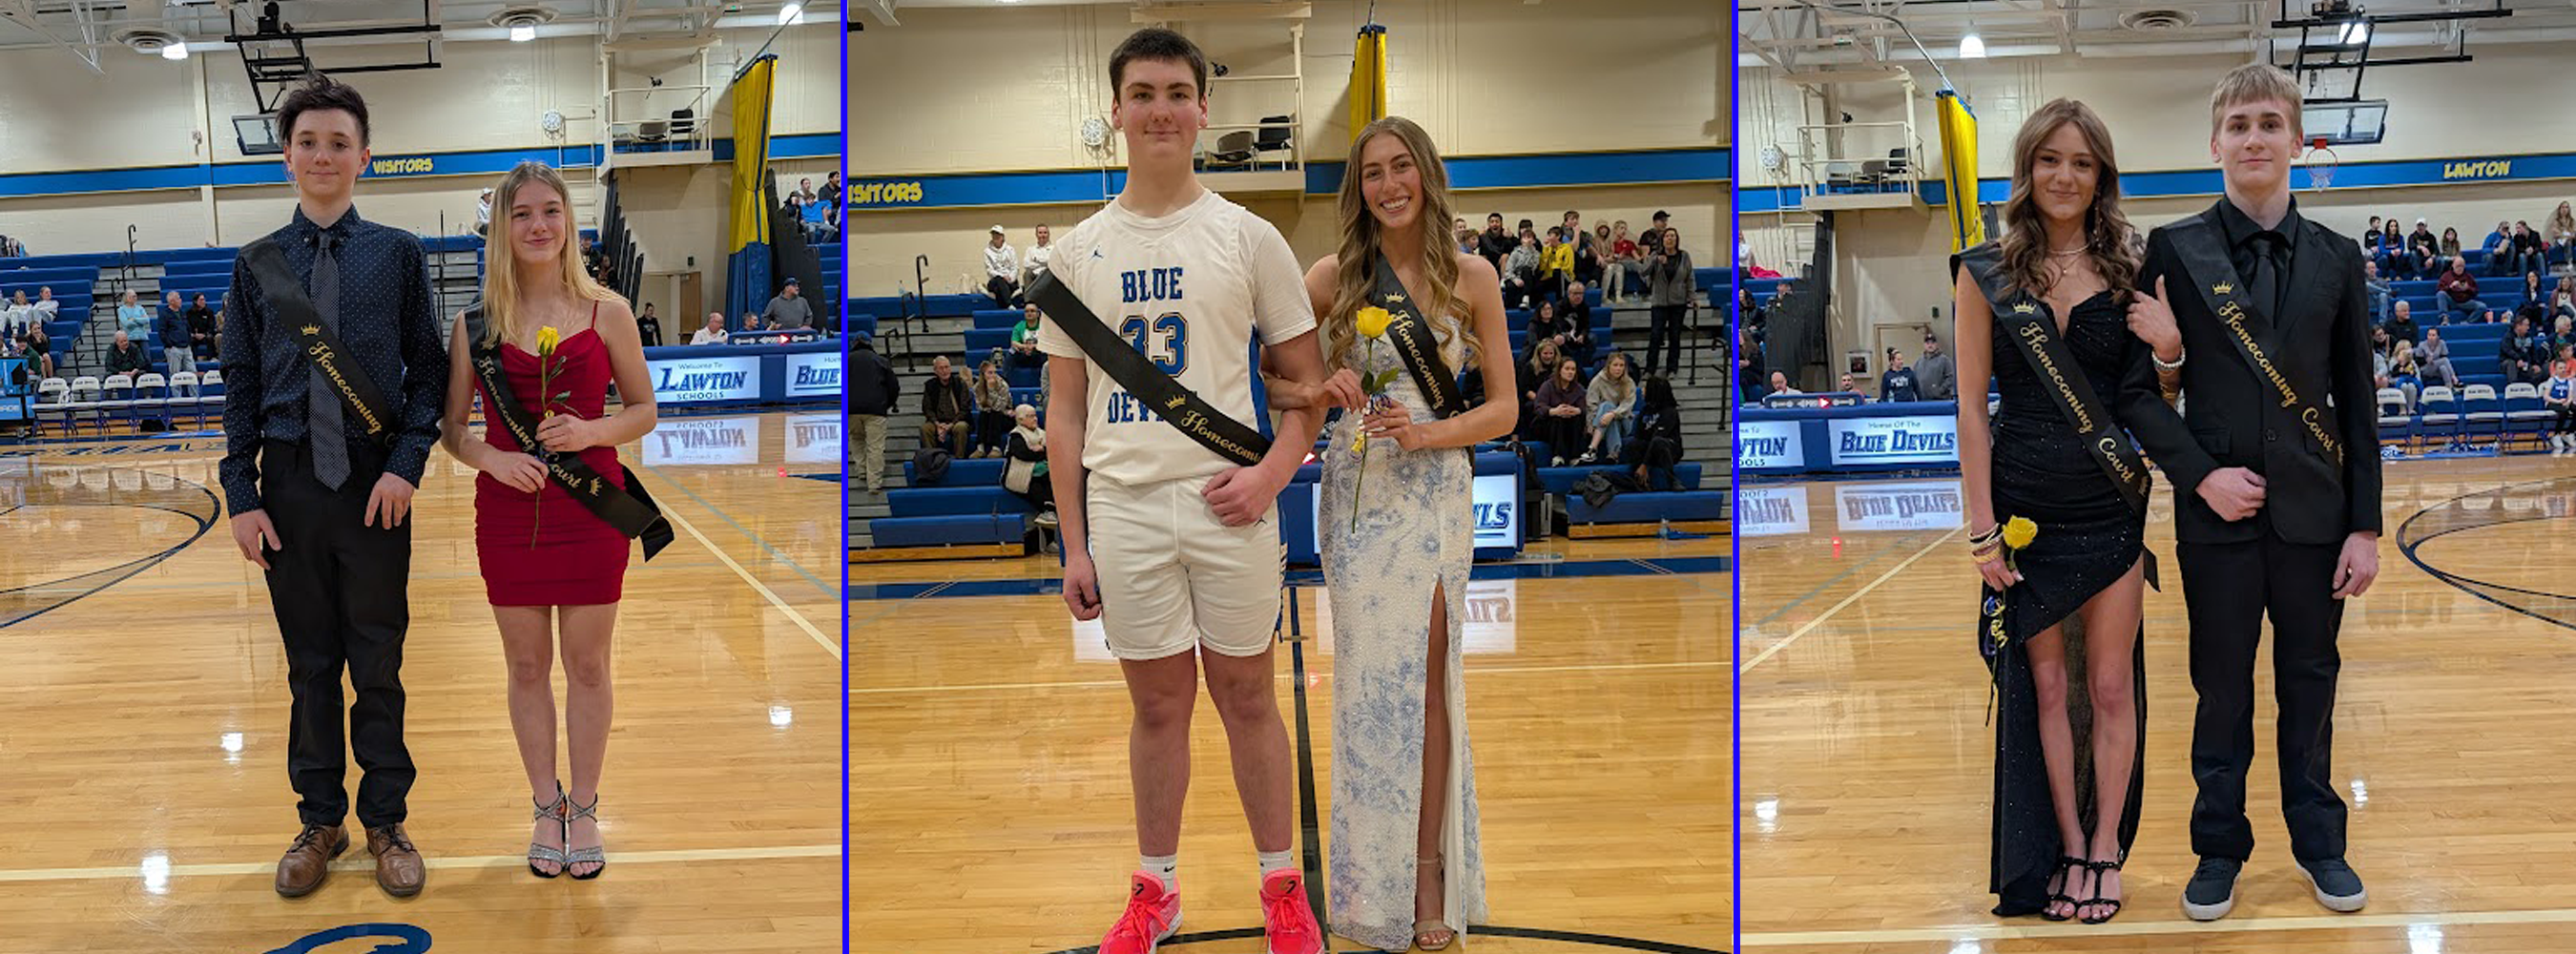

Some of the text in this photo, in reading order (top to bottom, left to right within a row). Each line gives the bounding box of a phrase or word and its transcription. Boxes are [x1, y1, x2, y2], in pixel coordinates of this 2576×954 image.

[373, 158, 433, 175] VISITORS
[2443, 158, 2511, 179] LAWTON
[1121, 267, 1183, 302] BLUE
[794, 364, 841, 385] BLUE
[1394, 309, 1444, 410] Homecoming
[309, 341, 383, 435] Homecoming
[656, 367, 747, 392] LAWTON
[2218, 301, 2335, 452] Homecoming Court
[478, 356, 535, 452] Homecoming
[676, 391, 724, 401] SCHOOLS
[1108, 391, 1164, 424] DEV
[2020, 321, 2135, 483] Homecoming Court
[1839, 429, 1955, 453] BLUE DEVILS
